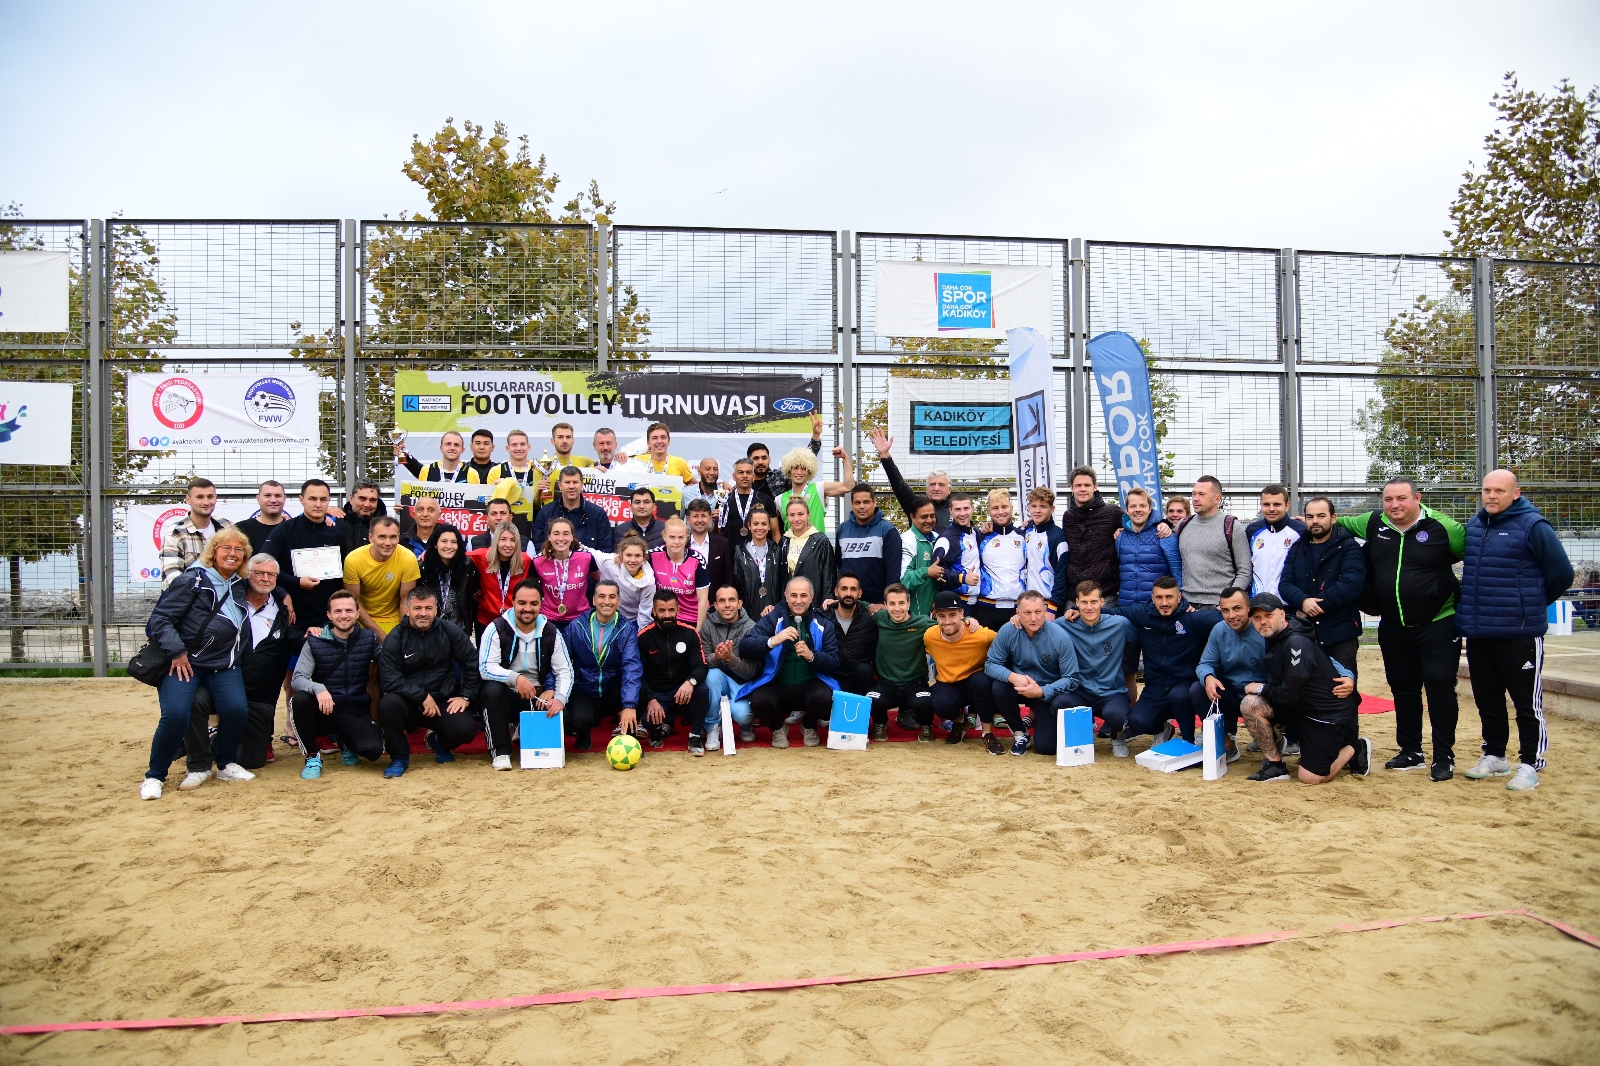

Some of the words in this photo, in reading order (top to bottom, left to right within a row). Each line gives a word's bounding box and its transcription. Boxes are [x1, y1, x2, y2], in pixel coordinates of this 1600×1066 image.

[942, 290, 987, 304] SPOR
[942, 309, 987, 318] KADIKÖY
[461, 381, 555, 392] ULUSLARARASI
[461, 394, 618, 414] FOOTVOLLEY
[625, 394, 765, 415] TURNUVASI
[258, 414, 282, 422] FWW
[923, 409, 985, 422] KADIKÖY
[172, 437, 202, 445] ayaktenisi
[923, 432, 1001, 446] BELEDİYESİ
[844, 541, 872, 552] 1996
